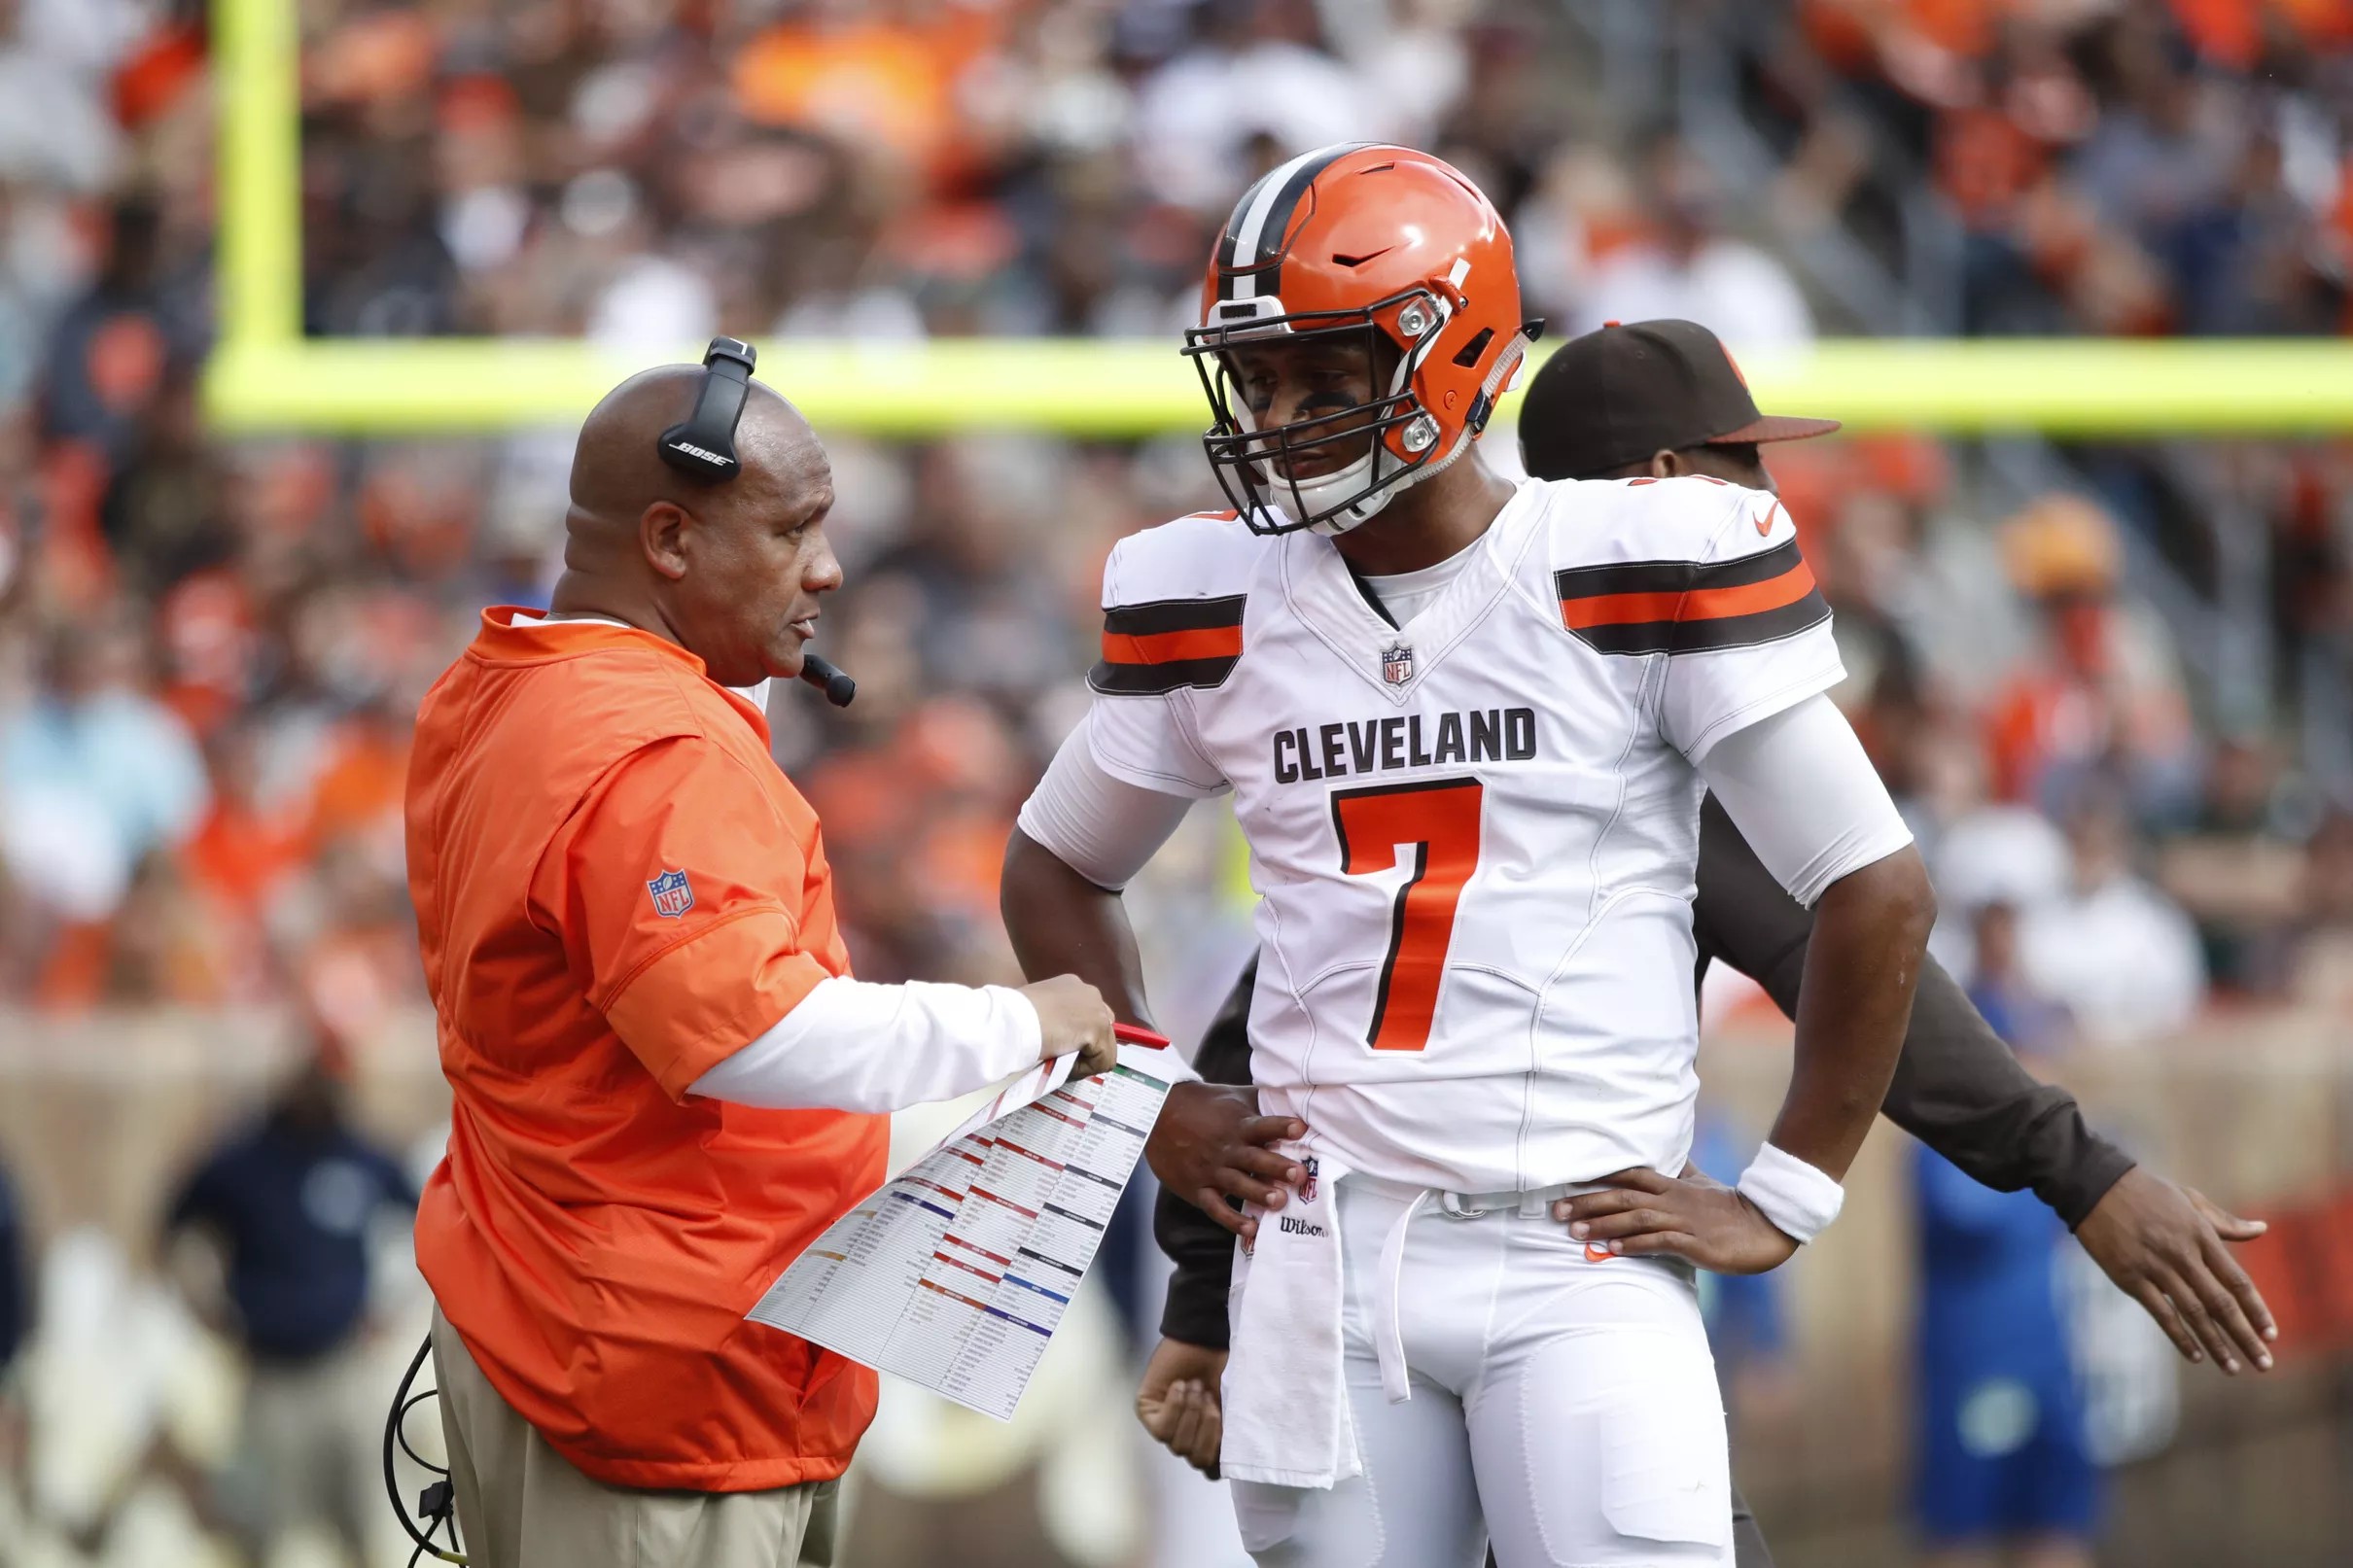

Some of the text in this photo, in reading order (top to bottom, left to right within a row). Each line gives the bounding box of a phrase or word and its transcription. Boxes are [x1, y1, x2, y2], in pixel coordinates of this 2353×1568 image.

[668, 441, 734, 467] BOSE
[1387, 661, 1411, 681] NFL
[1273, 707, 1537, 784] CLEVELAND
[657, 889, 690, 912] NFL
[1329, 776, 1485, 1053] 7
[1280, 1215, 1325, 1237] Wilson
